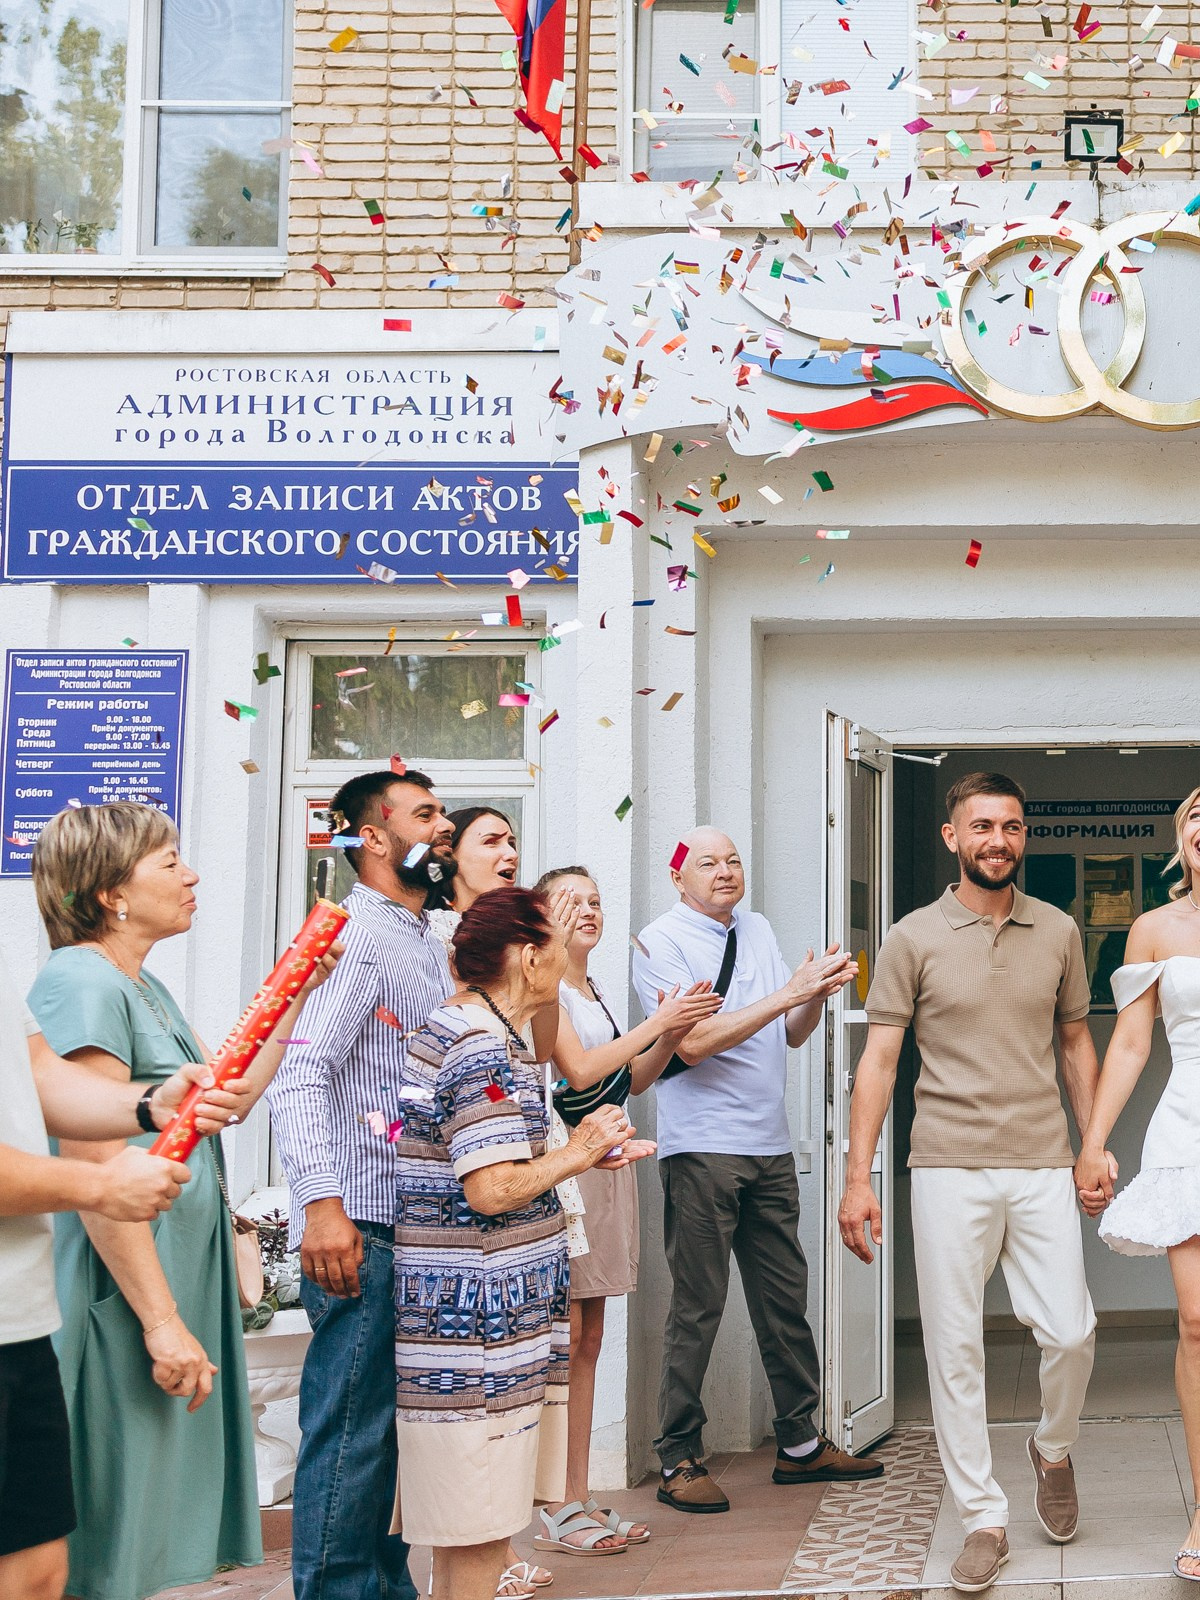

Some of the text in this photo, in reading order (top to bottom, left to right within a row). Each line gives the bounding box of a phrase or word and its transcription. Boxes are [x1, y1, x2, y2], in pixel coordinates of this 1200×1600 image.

[176, 369, 450, 383] РОСТОВСКАЯ ОБЛАСТЬ
[116, 394, 513, 421] АДМИНИСТРАЦИЯ
[116, 418, 513, 448] города Волгодонска
[77, 485, 542, 515] ОТДЕЛ ЗАПИСИ АКТОВ
[27, 529, 339, 560] ГРАЖДАНСКОГО
[16, 658, 38, 667] Отдел
[89, 659, 139, 667] гражданского
[140, 658, 177, 667] состояния
[31, 669, 161, 679] Администрации города Волгодонска
[60, 680, 131, 689] Ростовской области
[47, 699, 148, 711] Режим работы
[18, 718, 57, 727] Вторник
[23, 728, 51, 738] Среда
[92, 725, 116, 733] Приём
[131, 732, 150, 740] 17.00
[17, 739, 55, 748] Пятница
[16, 760, 53, 769] Четверг
[92, 760, 161, 770] неприёмный день
[16, 788, 52, 798] Суббота
[89, 786, 113, 794] Приём
[1028, 804, 1170, 814] ЗАГС города ВОЛГОДОНСКА
[13, 820, 47, 830] Воскрес
[1027, 824, 1154, 839] ФОРМАЦИЯ
